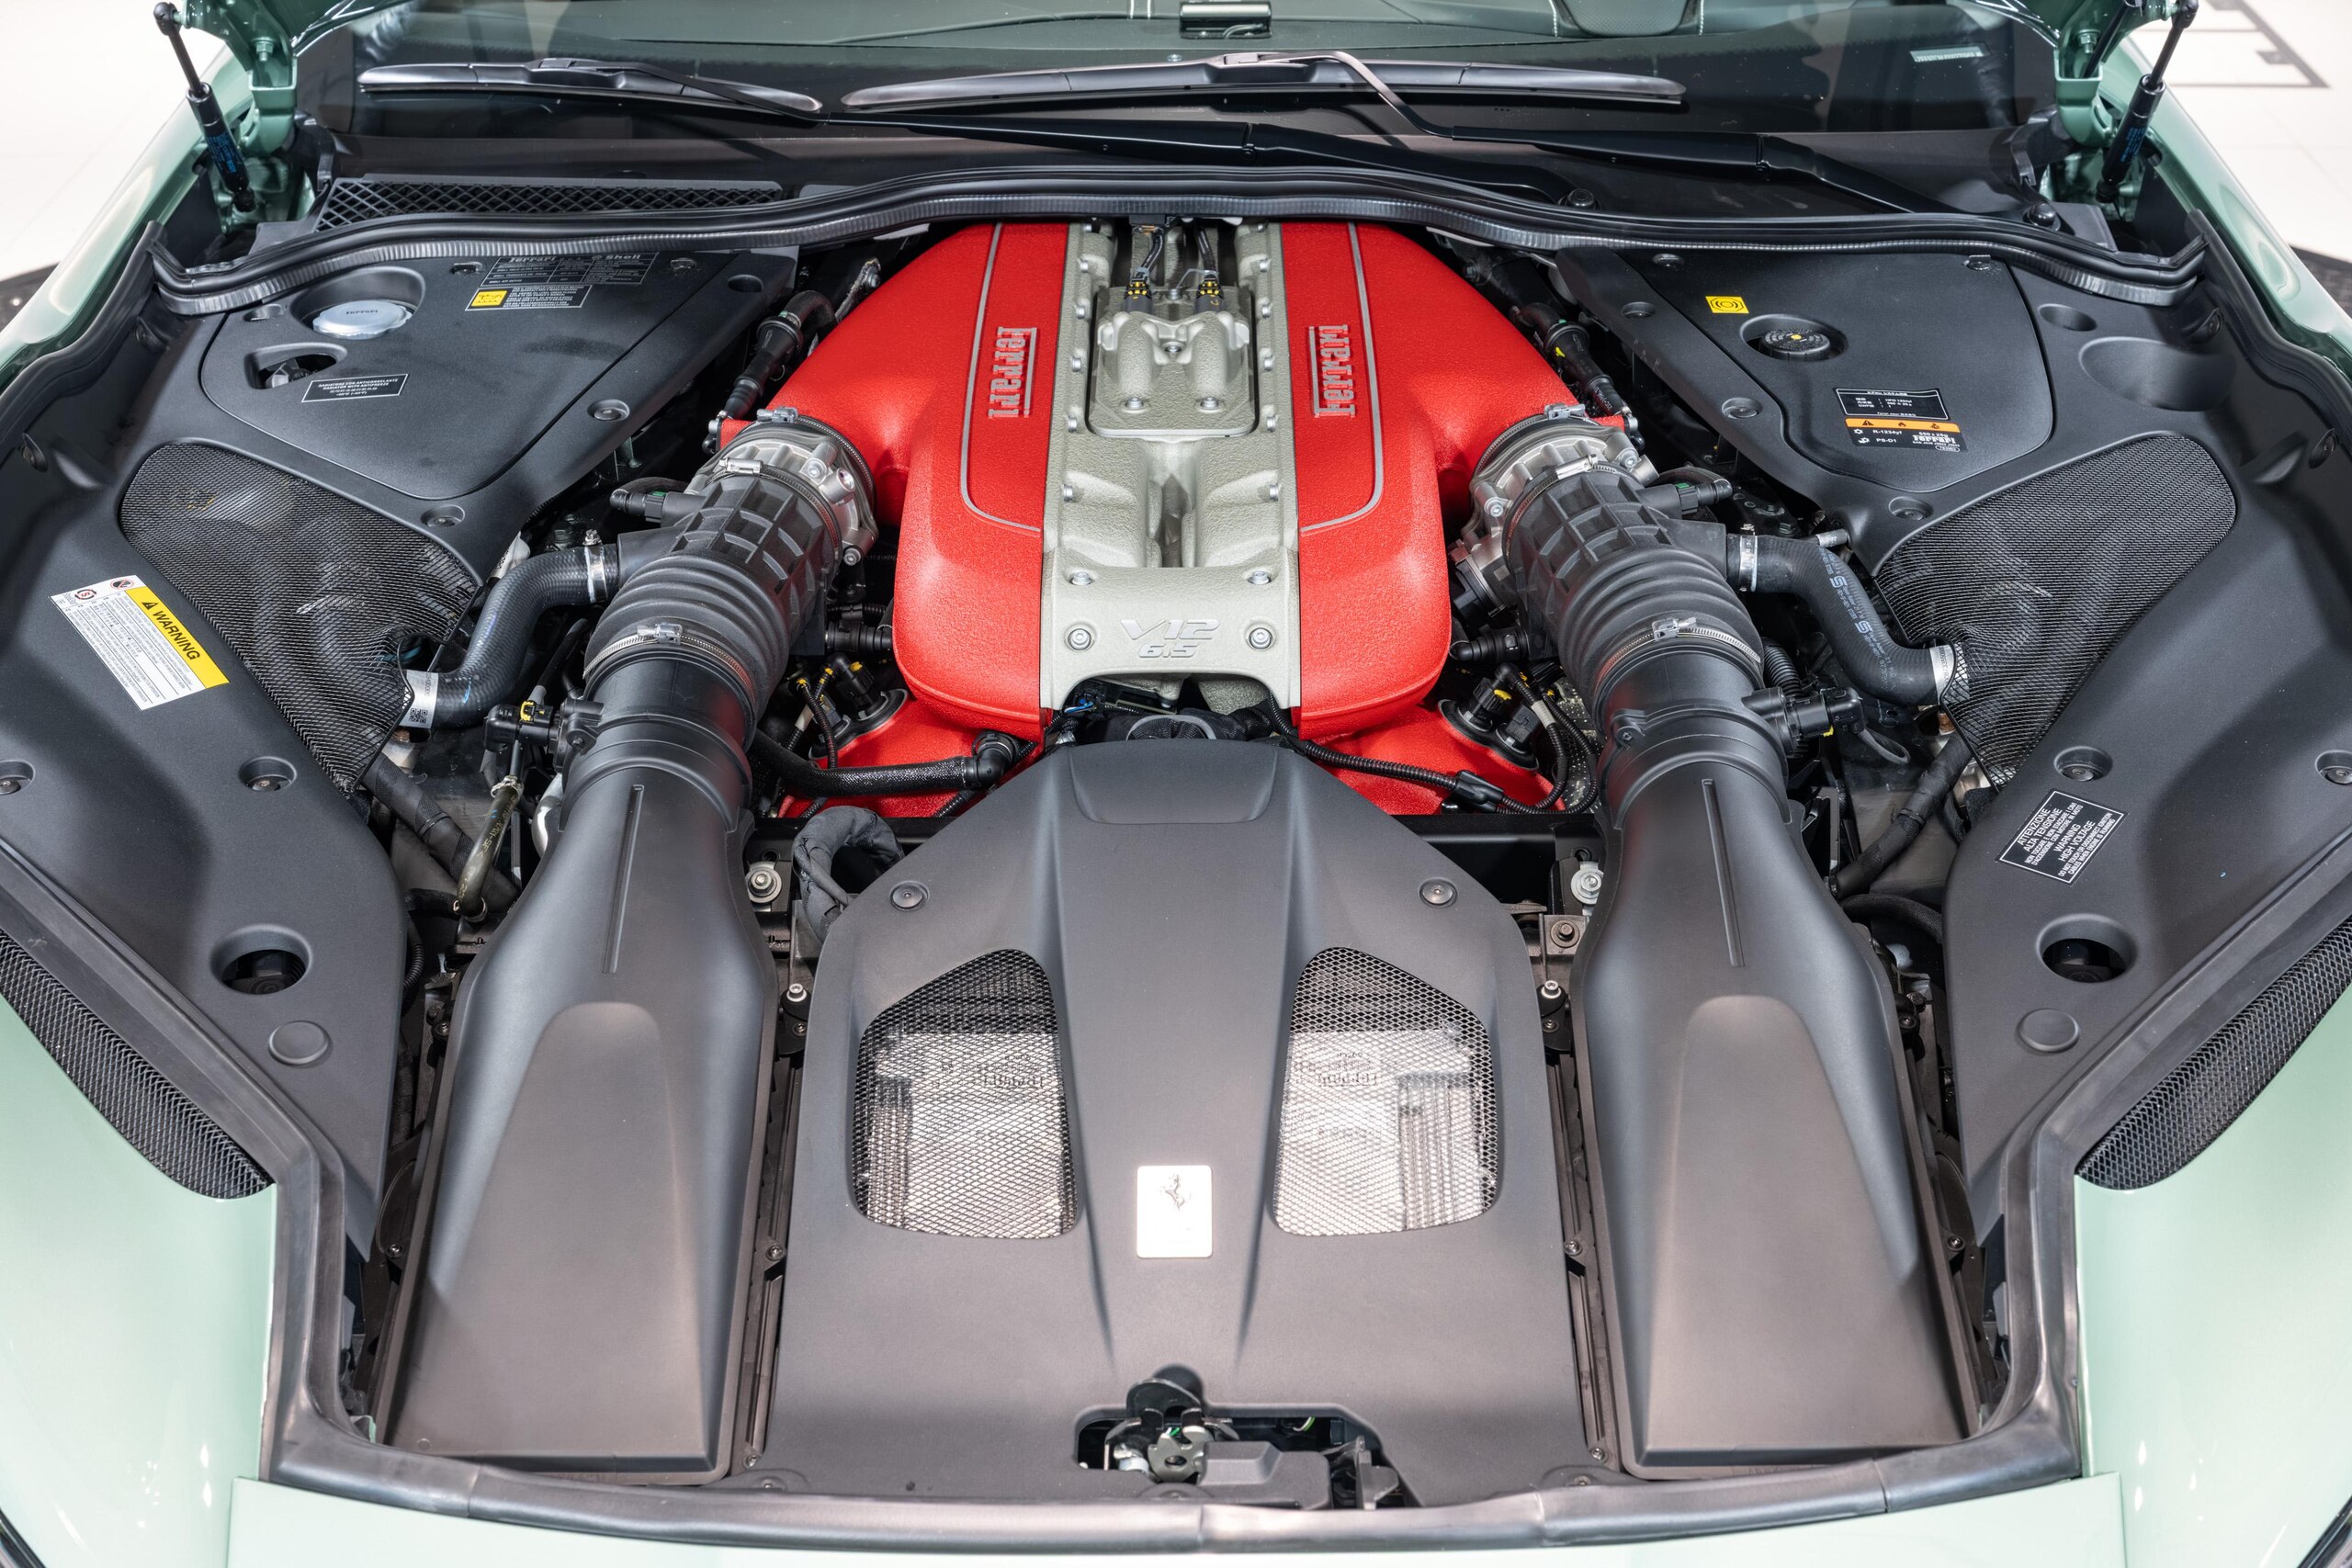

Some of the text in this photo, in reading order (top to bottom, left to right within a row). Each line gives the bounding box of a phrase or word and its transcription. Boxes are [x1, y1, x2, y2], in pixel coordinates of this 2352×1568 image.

[988, 327, 1037, 419] Ferrari
[1309, 324, 1356, 419] Ferrari
[153, 610, 200, 660] WARNING
[1121, 619, 1221, 640] V12
[1138, 642, 1200, 659] 6.5
[2018, 808, 2051, 845] ATTENZIONE
[2023, 808, 2062, 852] ALTA TENSIONE
[2053, 824, 2080, 852] WARNING
[2058, 821, 2095, 862] HIGH VOLTAGE
